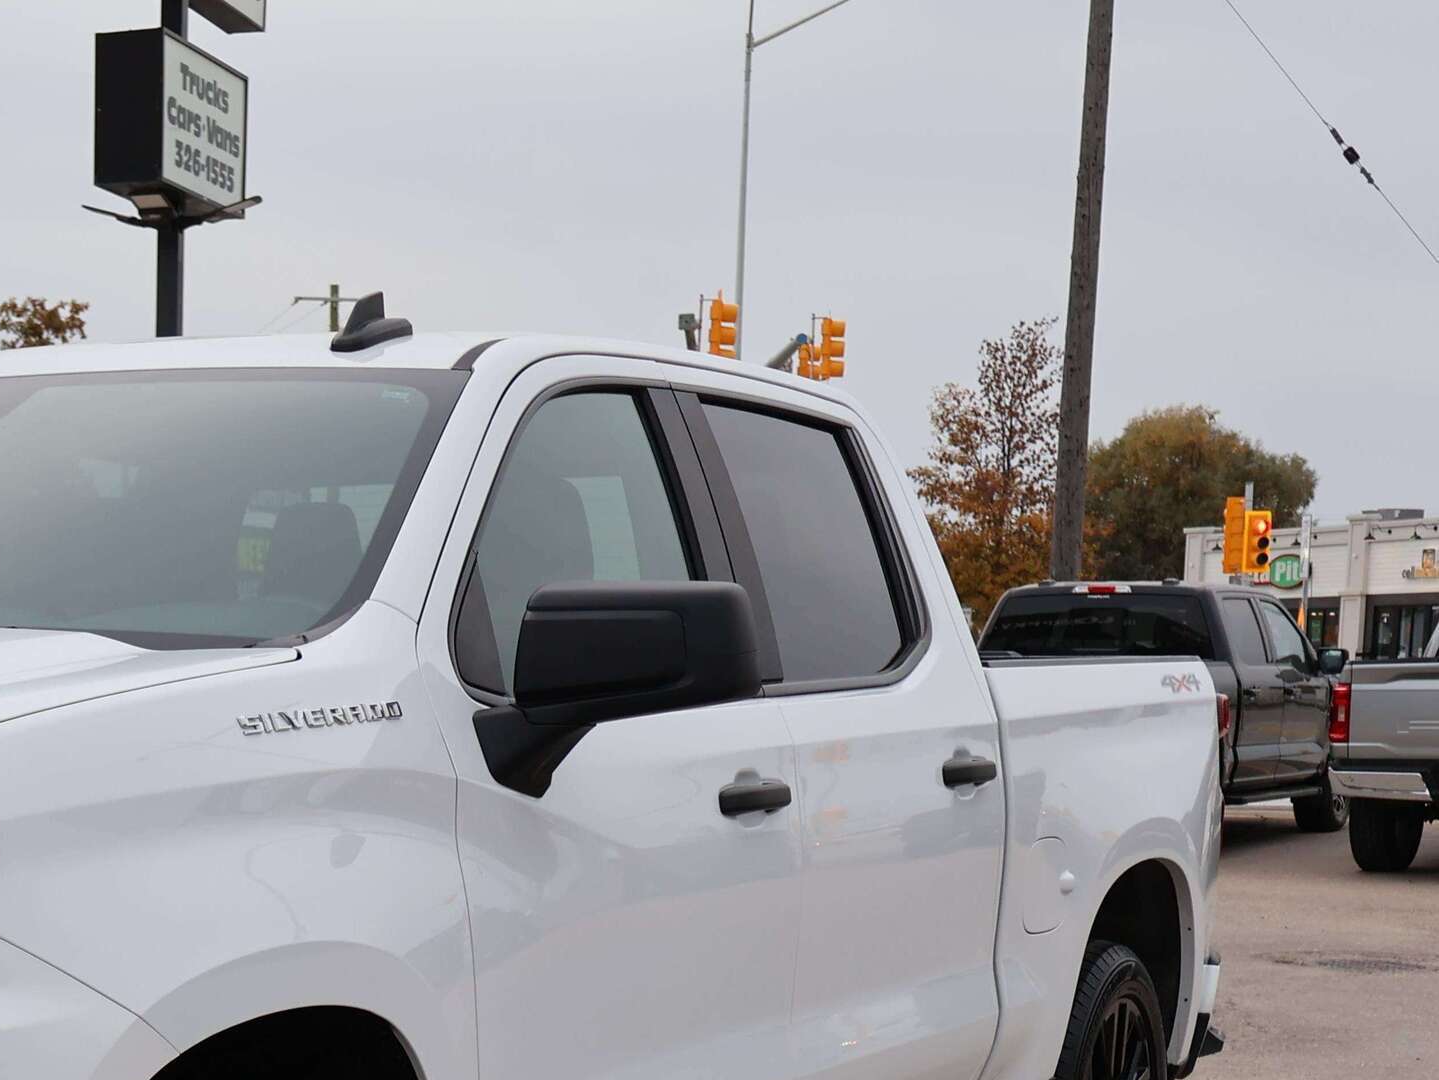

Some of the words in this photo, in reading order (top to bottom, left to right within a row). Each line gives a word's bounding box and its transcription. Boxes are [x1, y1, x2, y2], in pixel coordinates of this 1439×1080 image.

[180, 62, 229, 114] Trucks
[174, 139, 235, 193] 326-1555
[236, 700, 403, 736] SILVERADO
